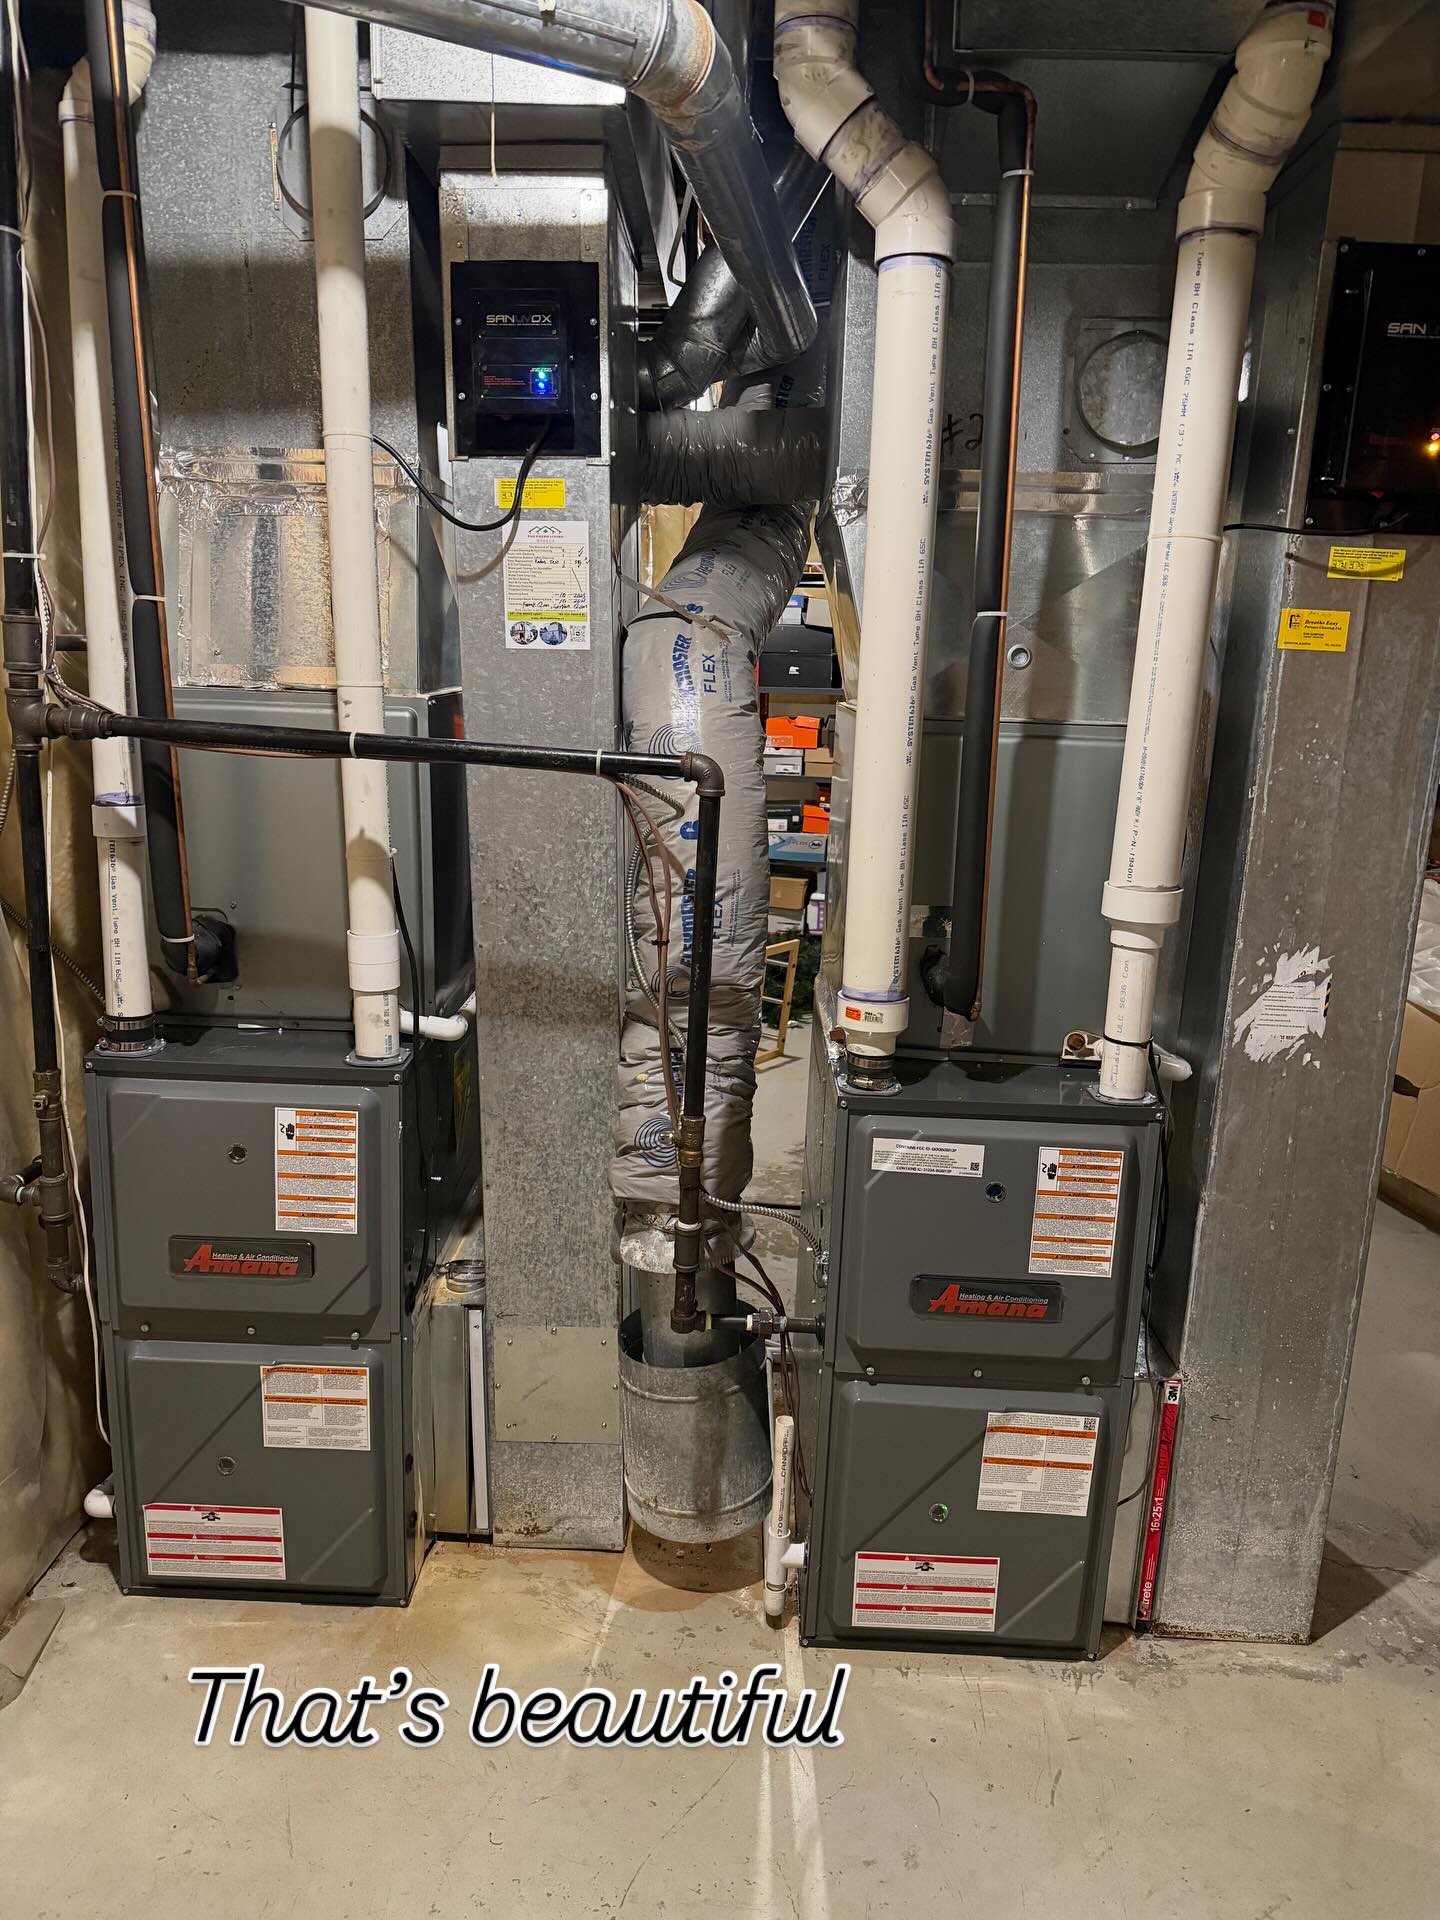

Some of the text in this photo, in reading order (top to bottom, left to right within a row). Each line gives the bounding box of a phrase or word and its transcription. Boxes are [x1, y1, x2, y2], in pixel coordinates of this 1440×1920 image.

[1190, 302, 1199, 335] Class
[916, 580, 924, 606] Class
[702, 653, 717, 694] FLEX
[184, 1244, 299, 1276] Amana
[212, 1252, 237, 1260] Heating
[245, 1253, 256, 1261] Air
[256, 1254, 299, 1262] Conditioning
[928, 1284, 1048, 1318] Amana
[959, 1292, 985, 1301] Heating
[1004, 1295, 1049, 1304] Conditioning
[1168, 1386, 1179, 1402] 3M
